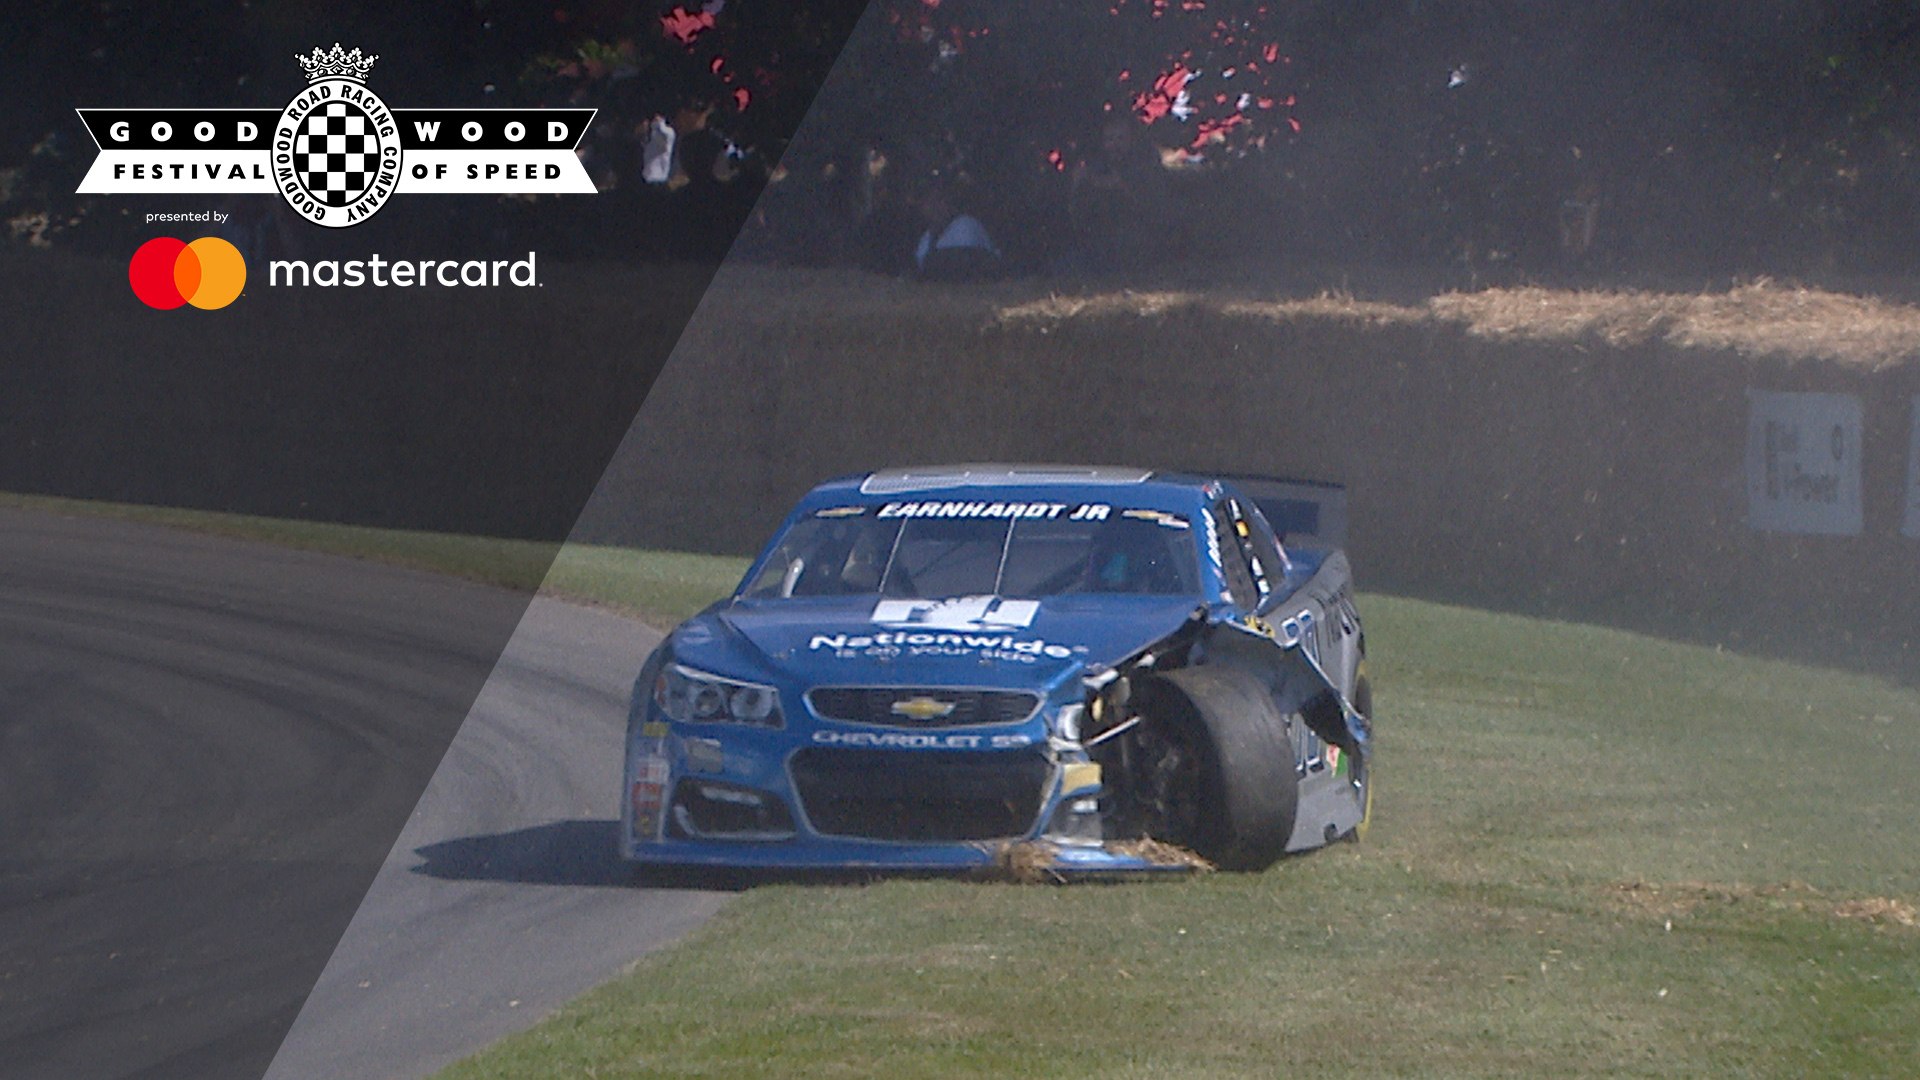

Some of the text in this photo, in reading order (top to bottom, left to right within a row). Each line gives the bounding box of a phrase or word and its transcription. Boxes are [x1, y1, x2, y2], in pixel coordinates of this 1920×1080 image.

[877, 501, 1111, 520] EARNHARDT JR
[812, 729, 983, 748] CHEVROLET
